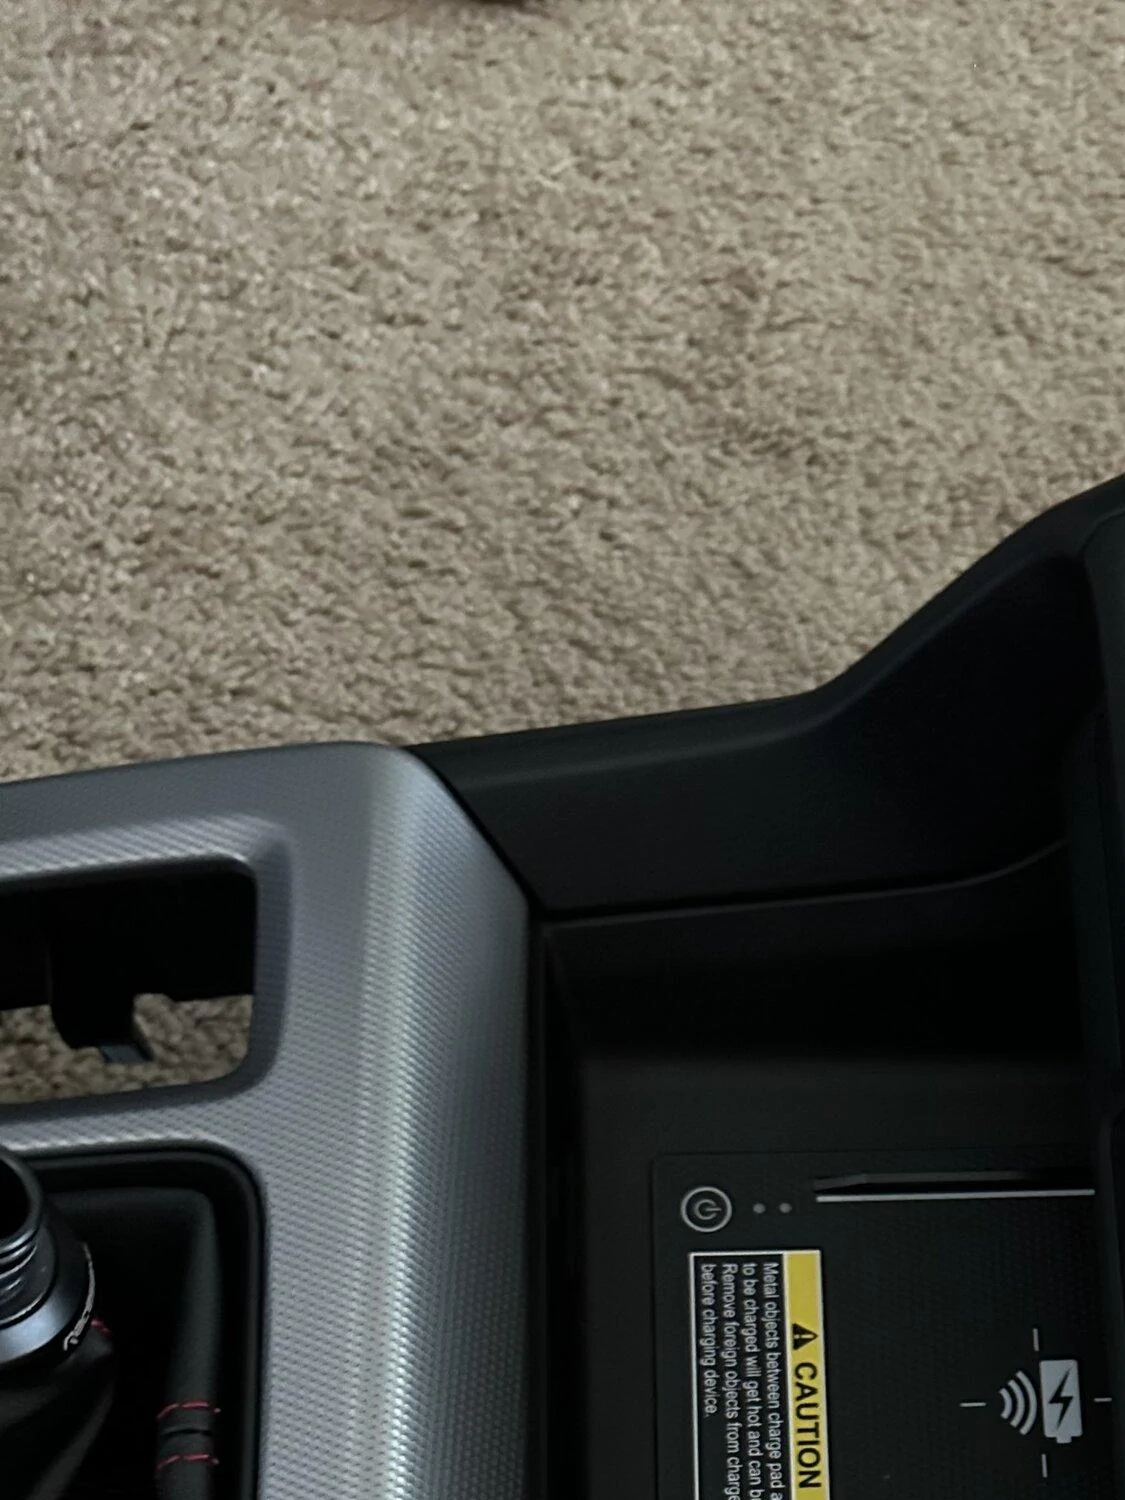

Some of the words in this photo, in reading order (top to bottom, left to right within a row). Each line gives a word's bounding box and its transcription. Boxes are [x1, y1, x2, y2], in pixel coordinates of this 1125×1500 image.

[701, 1263, 718, 1306] before
[722, 1263, 738, 1318] Remove
[742, 1263, 758, 1275] to
[743, 1280, 759, 1295] be
[763, 1262, 780, 1298] Metal
[700, 1309, 720, 1366] charging
[721, 1321, 740, 1367] foreign
[741, 1299, 760, 1352] charged
[761, 1302, 781, 1349] objects
[745, 1355, 762, 1377] will
[766, 1352, 782, 1409] between
[704, 1369, 721, 1417] device.
[722, 1371, 741, 1419] objects
[742, 1380, 762, 1402] get
[726, 1422, 743, 1453] from
[747, 1406, 762, 1428] hot
[765, 1413, 784, 1459] charge
[795, 1362, 822, 1488] CAUTION
[748, 1432, 763, 1457] and
[749, 1460, 762, 1485] can
[766, 1463, 785, 1488] pad
